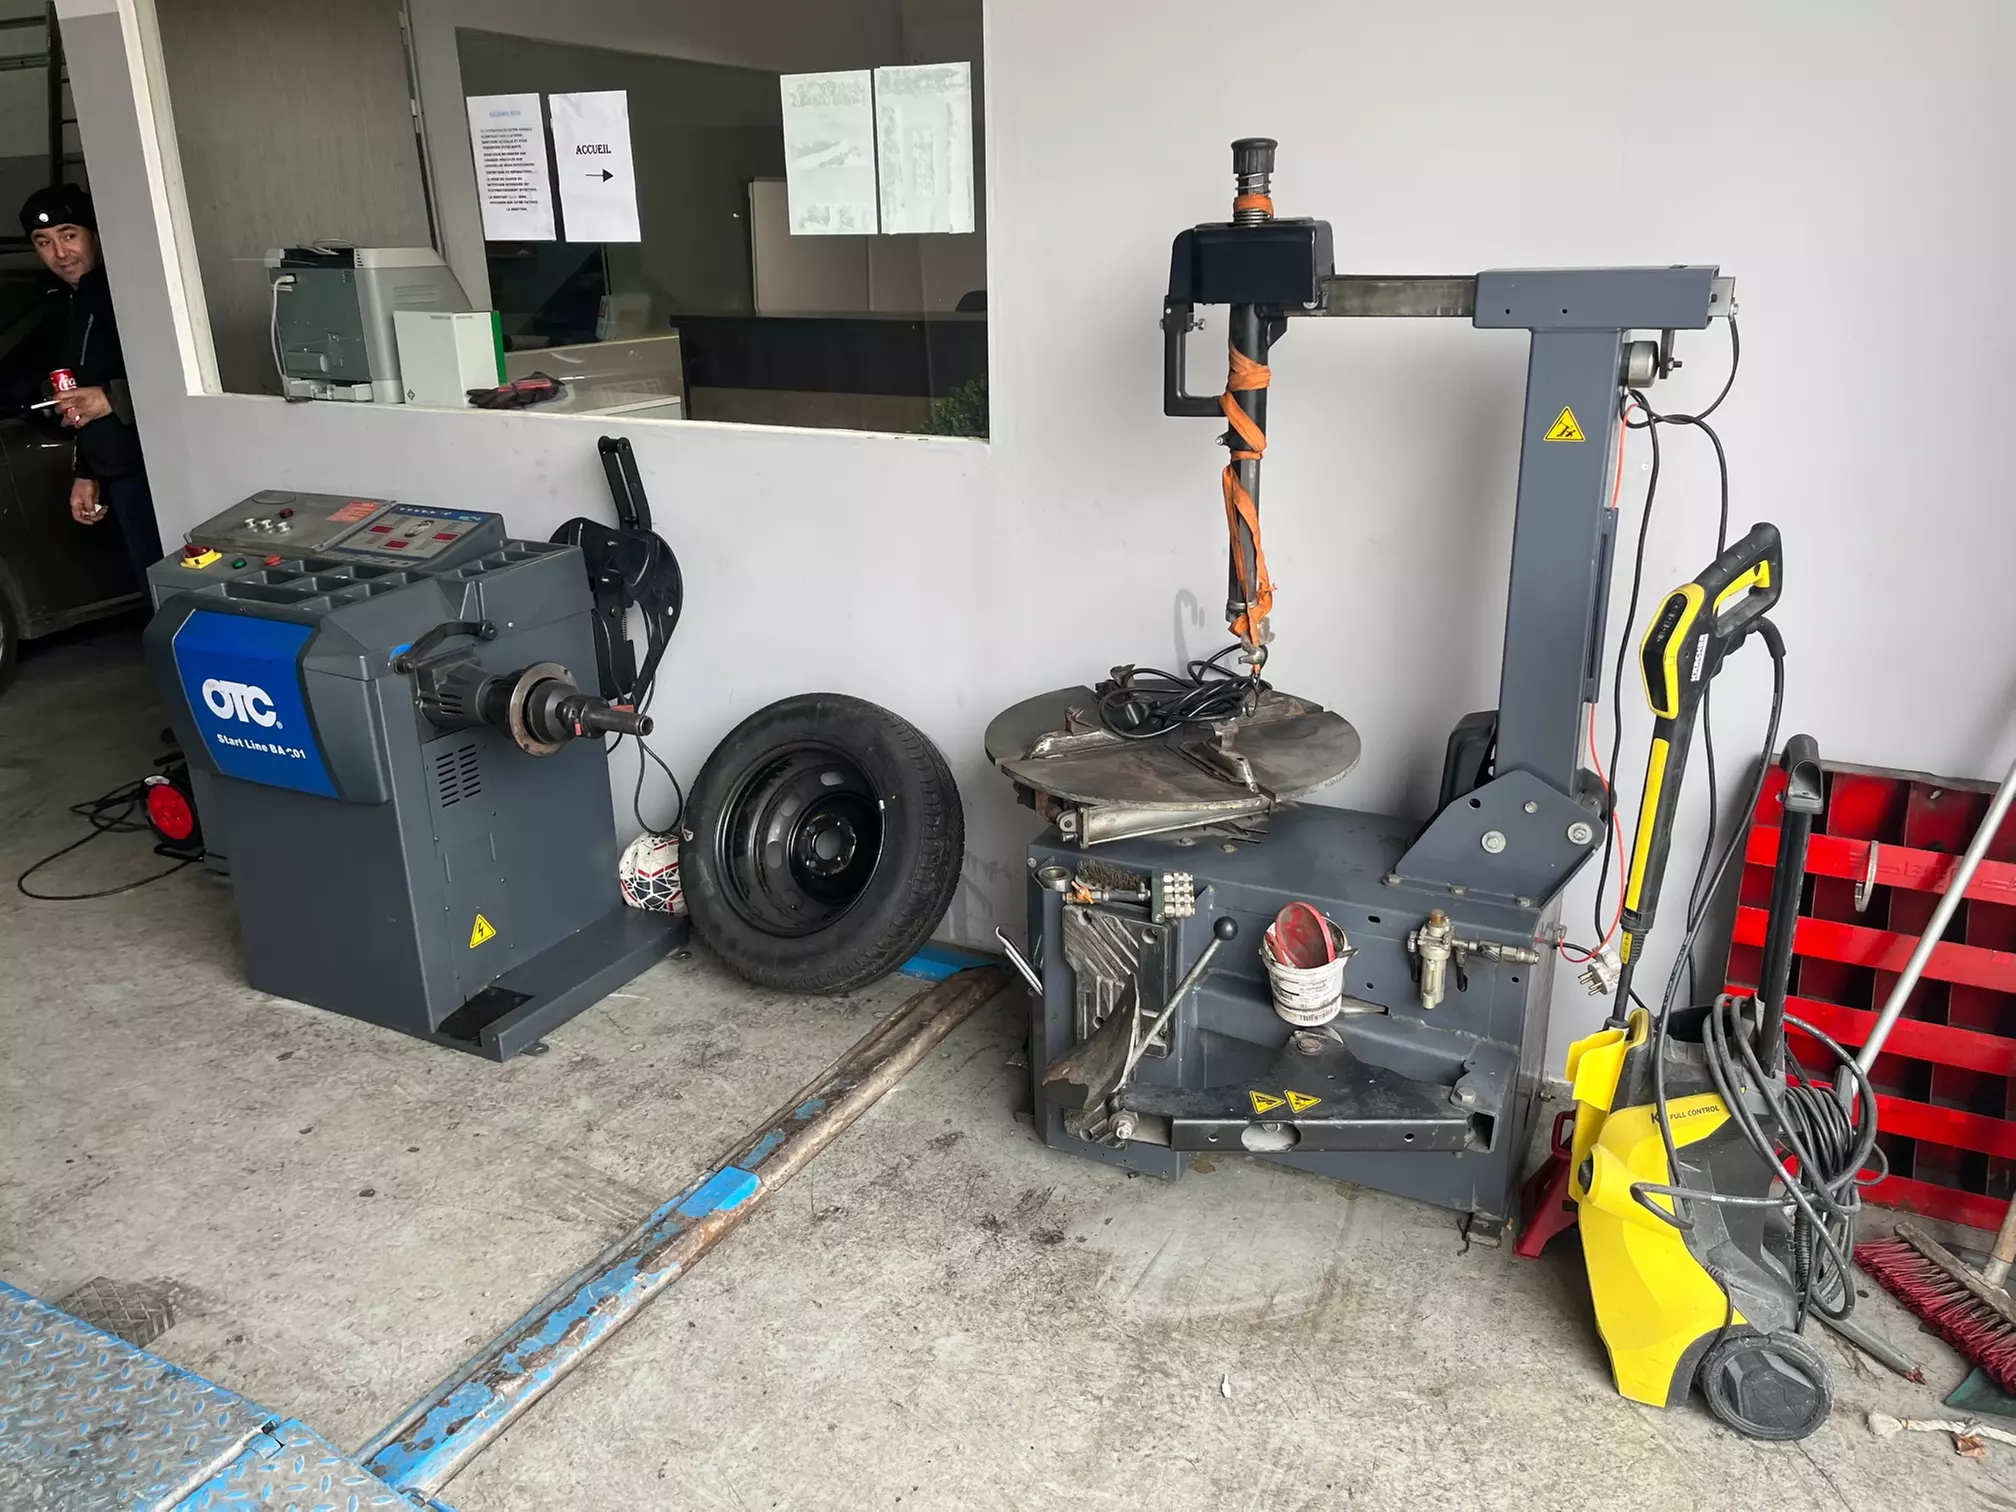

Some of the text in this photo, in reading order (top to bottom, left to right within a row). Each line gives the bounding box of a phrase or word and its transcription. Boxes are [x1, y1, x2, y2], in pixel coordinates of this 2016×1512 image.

[576, 144, 612, 155] ACCUEIL
[202, 678, 277, 728] OTC
[216, 733, 244, 748] Start
[244, 739, 268, 752] Line
[1670, 1112, 1687, 1120] FULL
[1687, 1105, 1720, 1117] CONTROL
